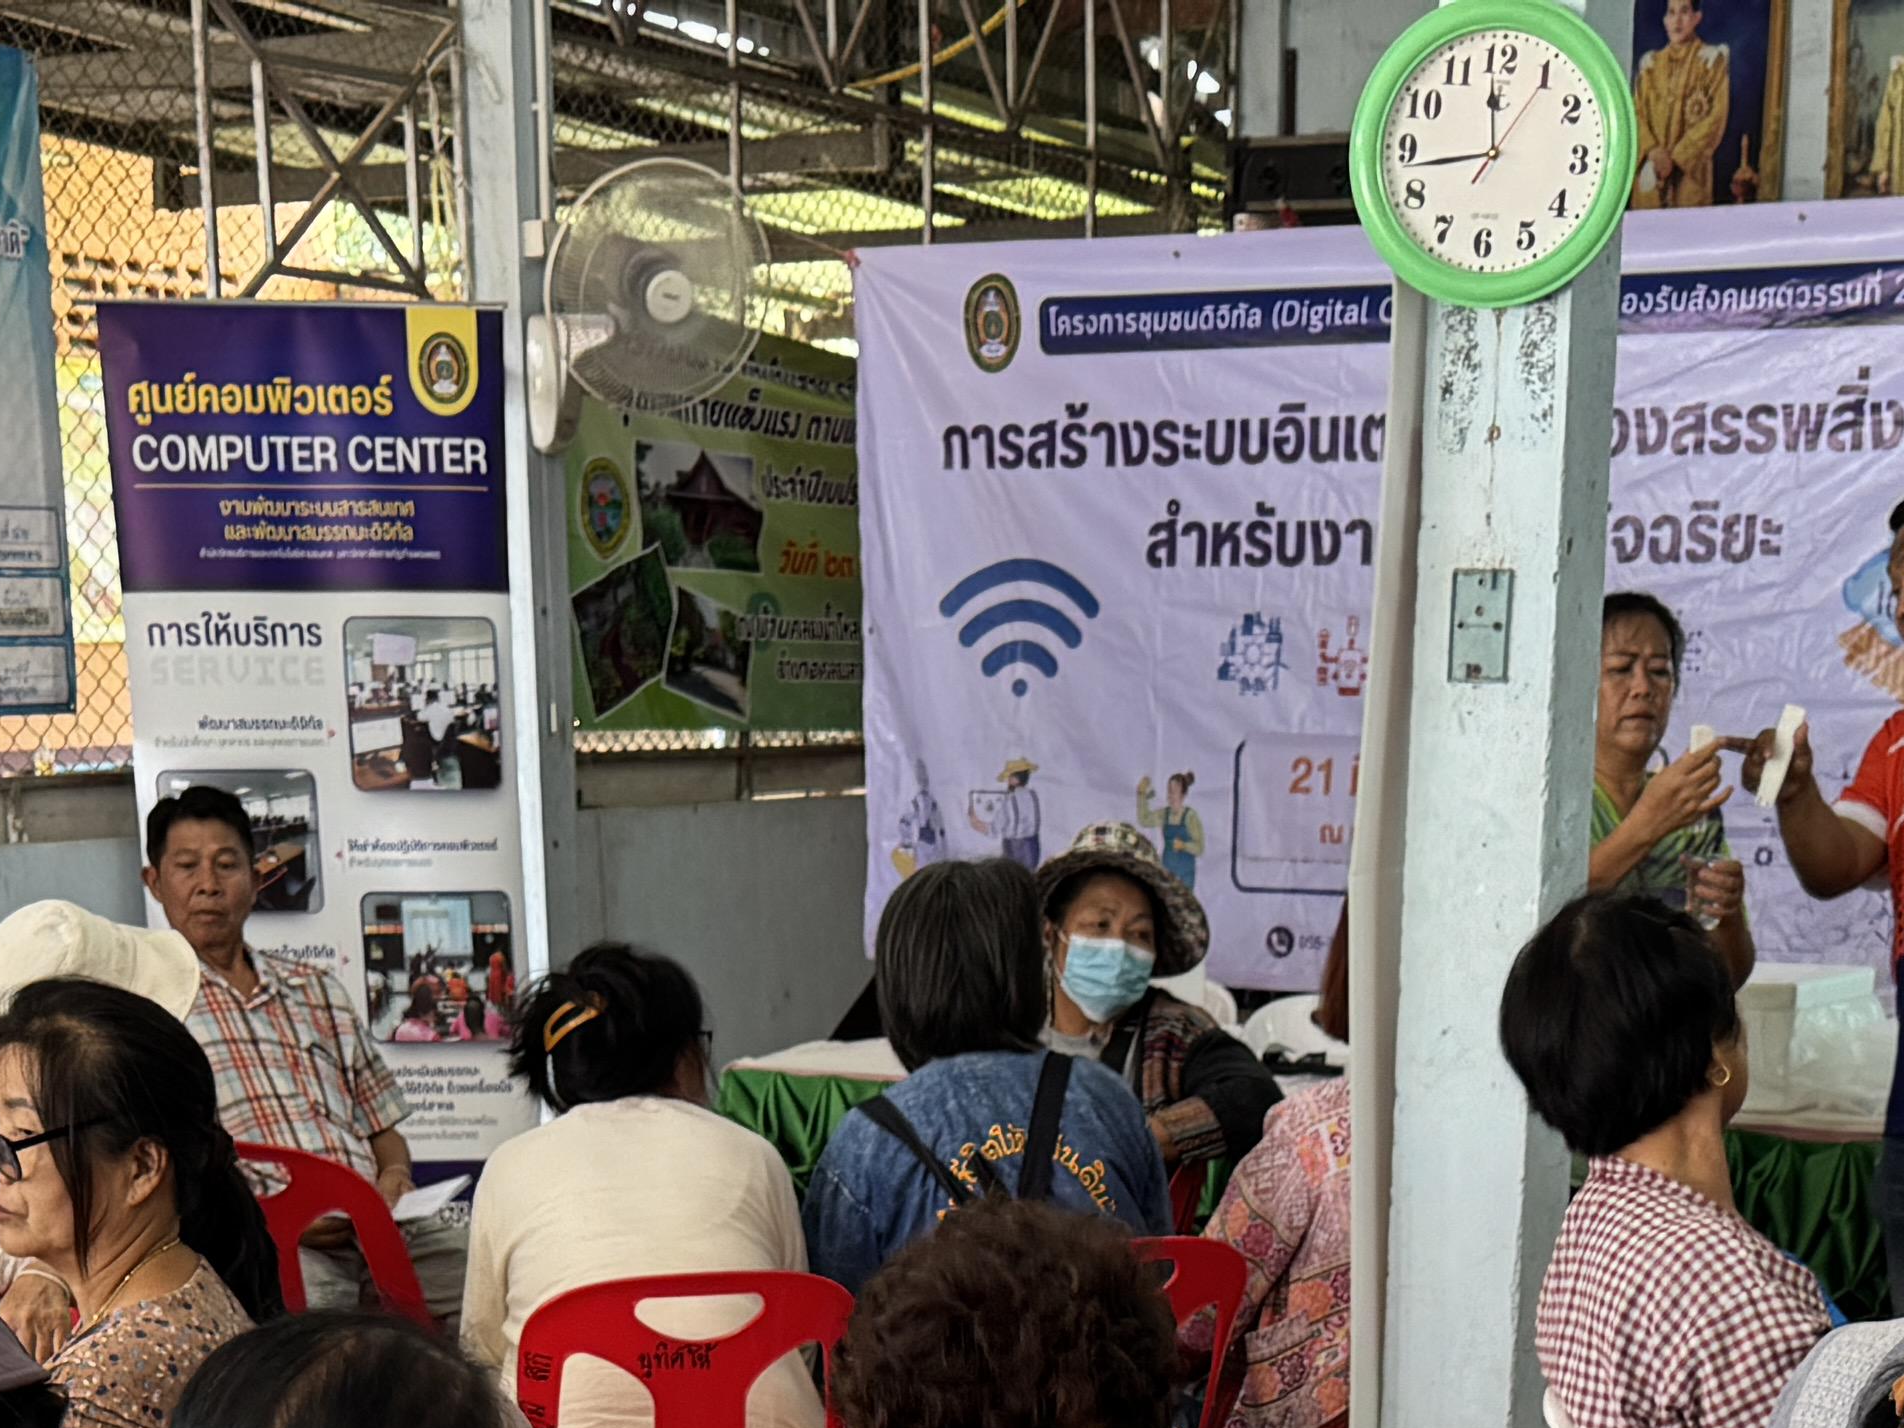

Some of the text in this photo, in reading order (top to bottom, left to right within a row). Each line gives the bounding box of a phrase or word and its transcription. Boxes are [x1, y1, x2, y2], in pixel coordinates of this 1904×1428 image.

[1443, 55, 1472, 86] 11
[1484, 43, 1518, 74] 12
[1539, 60, 1552, 90] 1
[1406, 88, 1441, 120] 10
[1561, 94, 1581, 124] 2
[1399, 133, 1417, 163] 9
[1569, 144, 1588, 175] 3
[1404, 179, 1426, 209] 8
[1548, 188, 1568, 218] 4
[1434, 215, 1453, 244] 7
[1473, 228, 1492, 257] 6
[1517, 219, 1536, 250] 5
[1049, 303, 1262, 340] โครงการชุมชนดิจิทัล
[1272, 296, 1367, 333] (Digital
[128, 372, 393, 425] ศูนย์คอมพิวเตอร์
[132, 434, 487, 475] COMPUTER CENTER
[148, 611, 322, 648] การให้บริการ
[150, 656, 325, 686] SERVICE
[1289, 756, 1334, 796] 21
